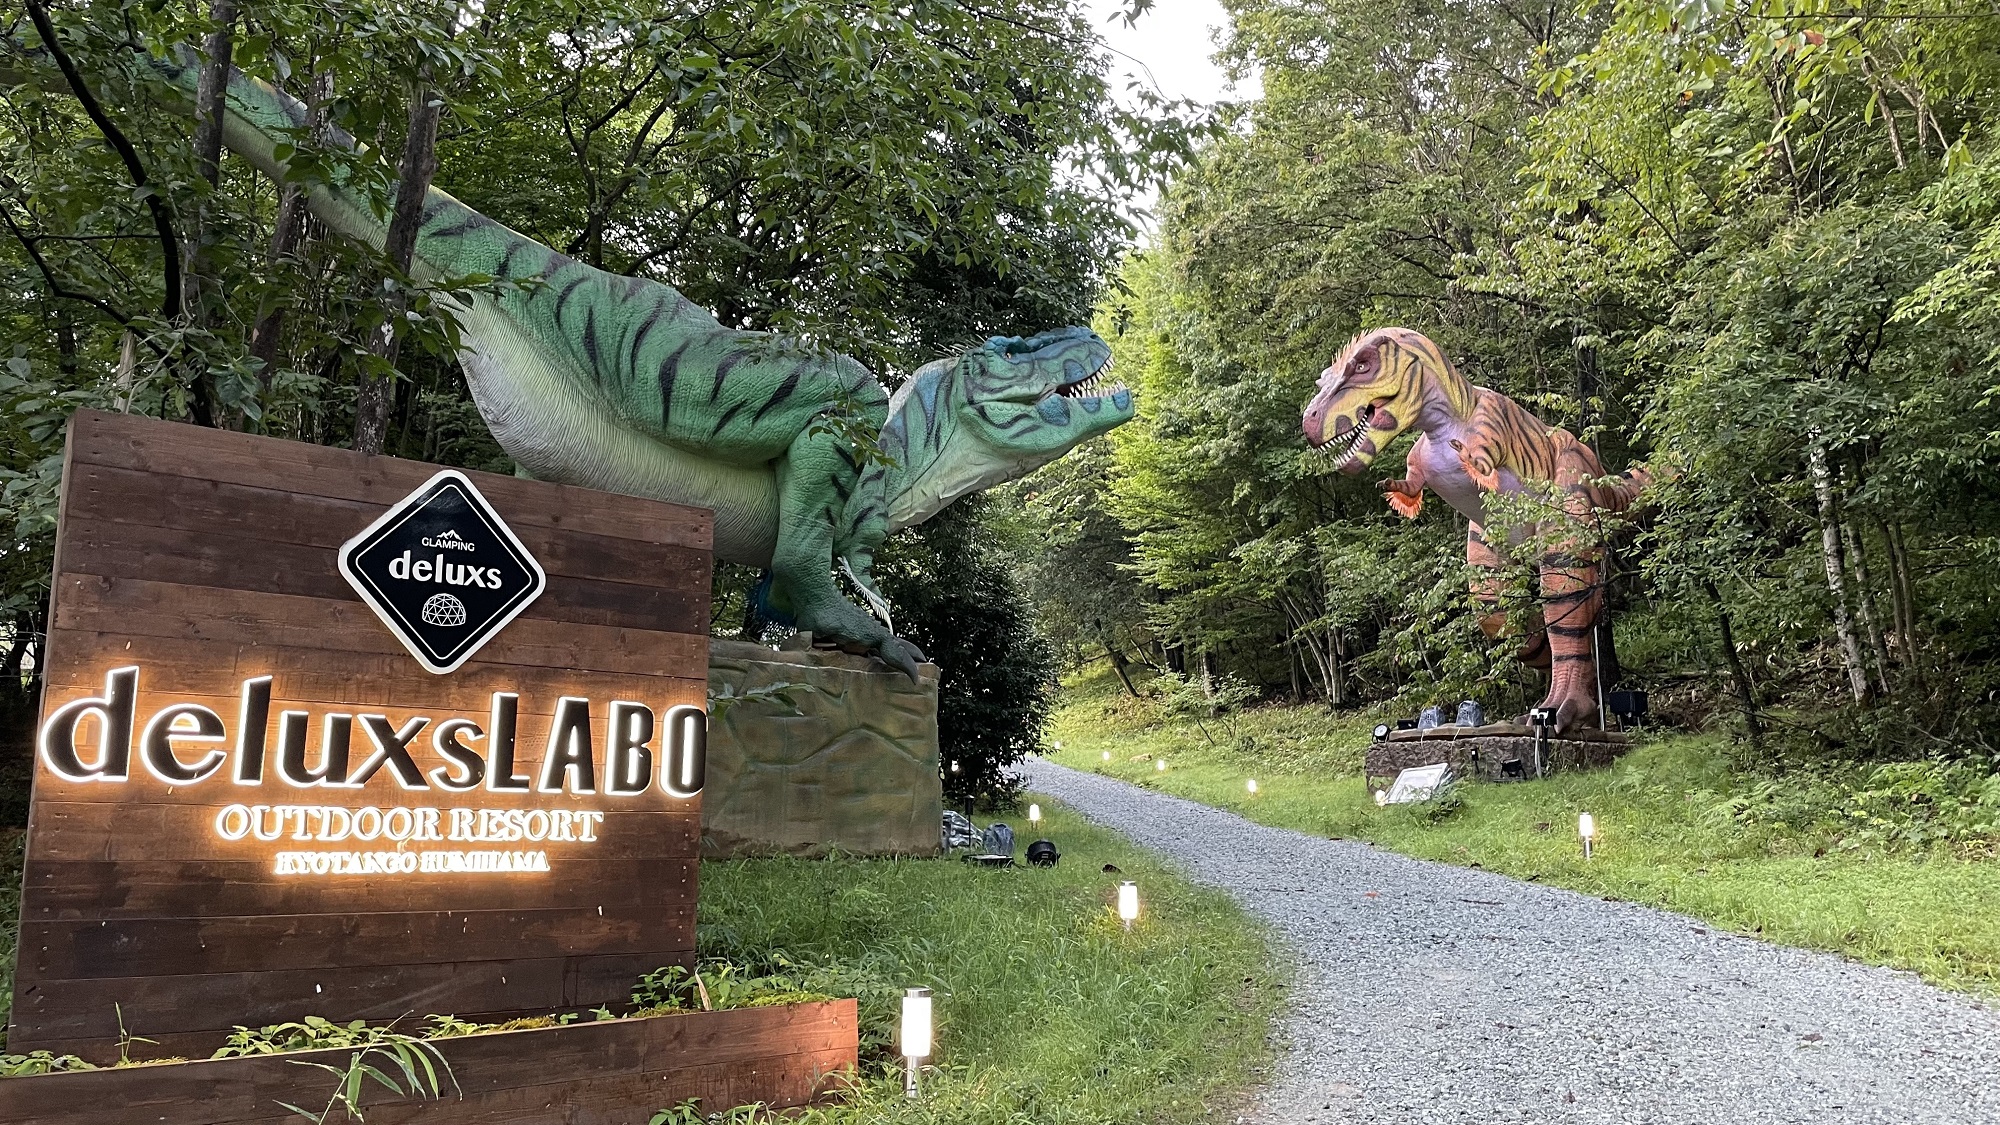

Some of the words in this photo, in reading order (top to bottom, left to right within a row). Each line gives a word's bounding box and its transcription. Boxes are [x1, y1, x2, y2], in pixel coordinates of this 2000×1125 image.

[422, 536, 475, 552] GLAMPING
[388, 550, 503, 590] deluxs
[215, 803, 443, 842] OUTDOOR
[448, 808, 604, 843] RESORT
[274, 851, 418, 874] KYOTANGO
